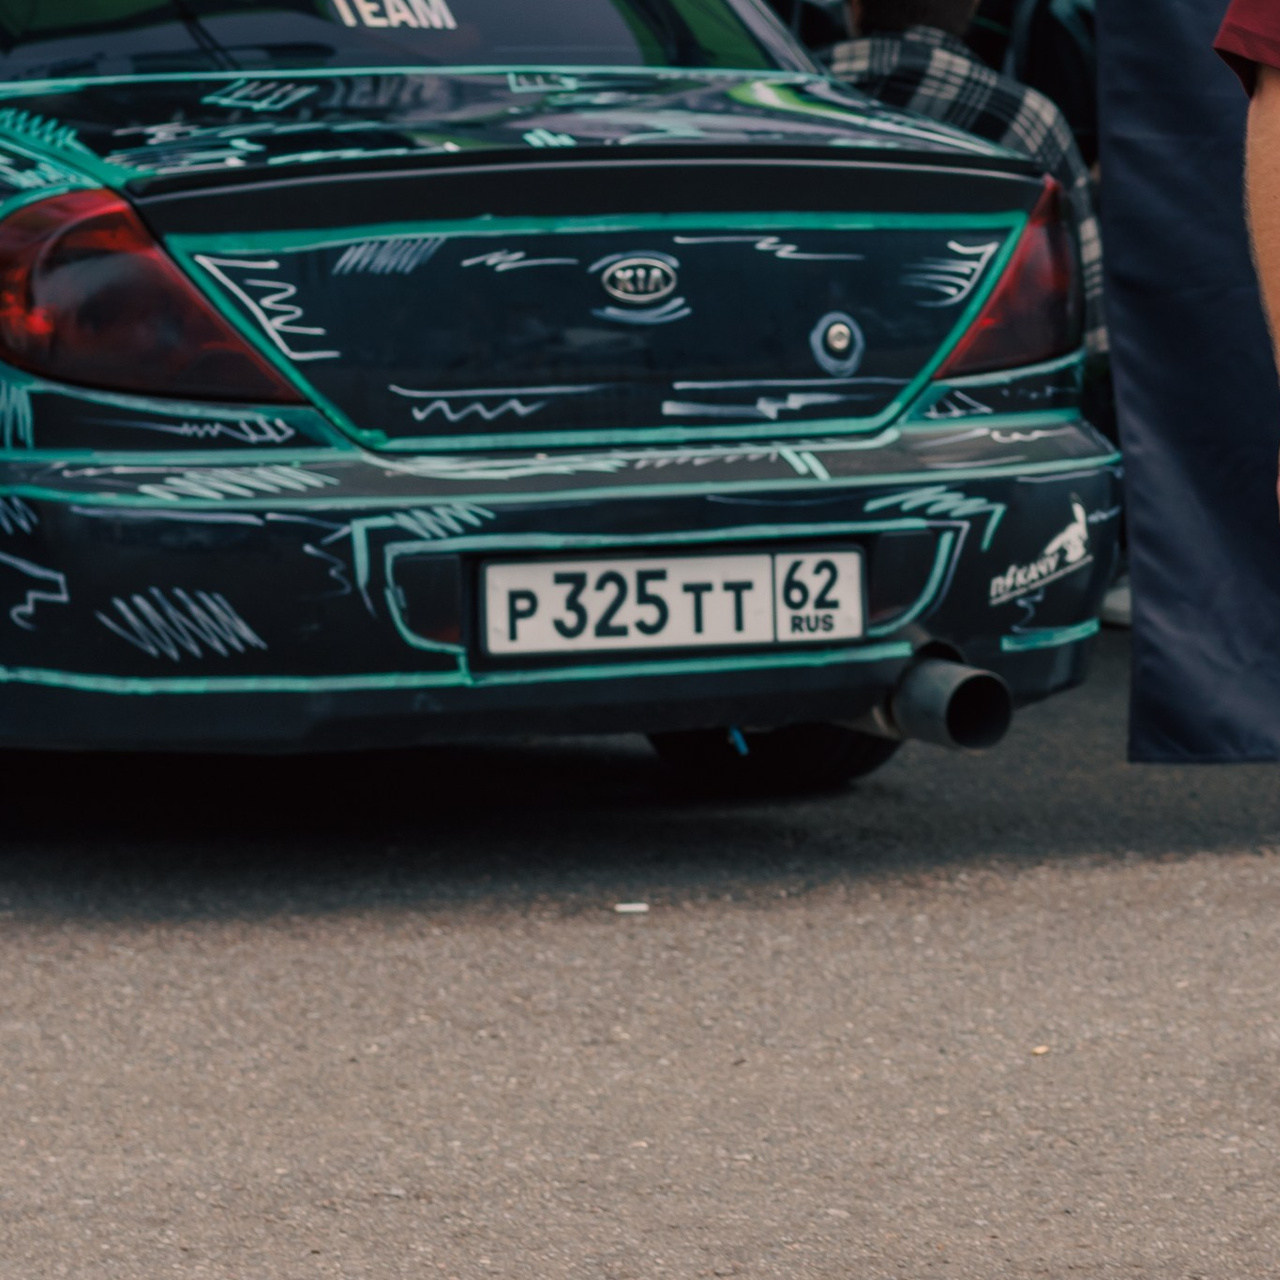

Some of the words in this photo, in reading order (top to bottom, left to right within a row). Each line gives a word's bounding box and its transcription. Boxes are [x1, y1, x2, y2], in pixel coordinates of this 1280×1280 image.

[613, 267, 668, 293] KIA
[782, 559, 840, 611] 62
[789, 613, 835, 634] RUS
